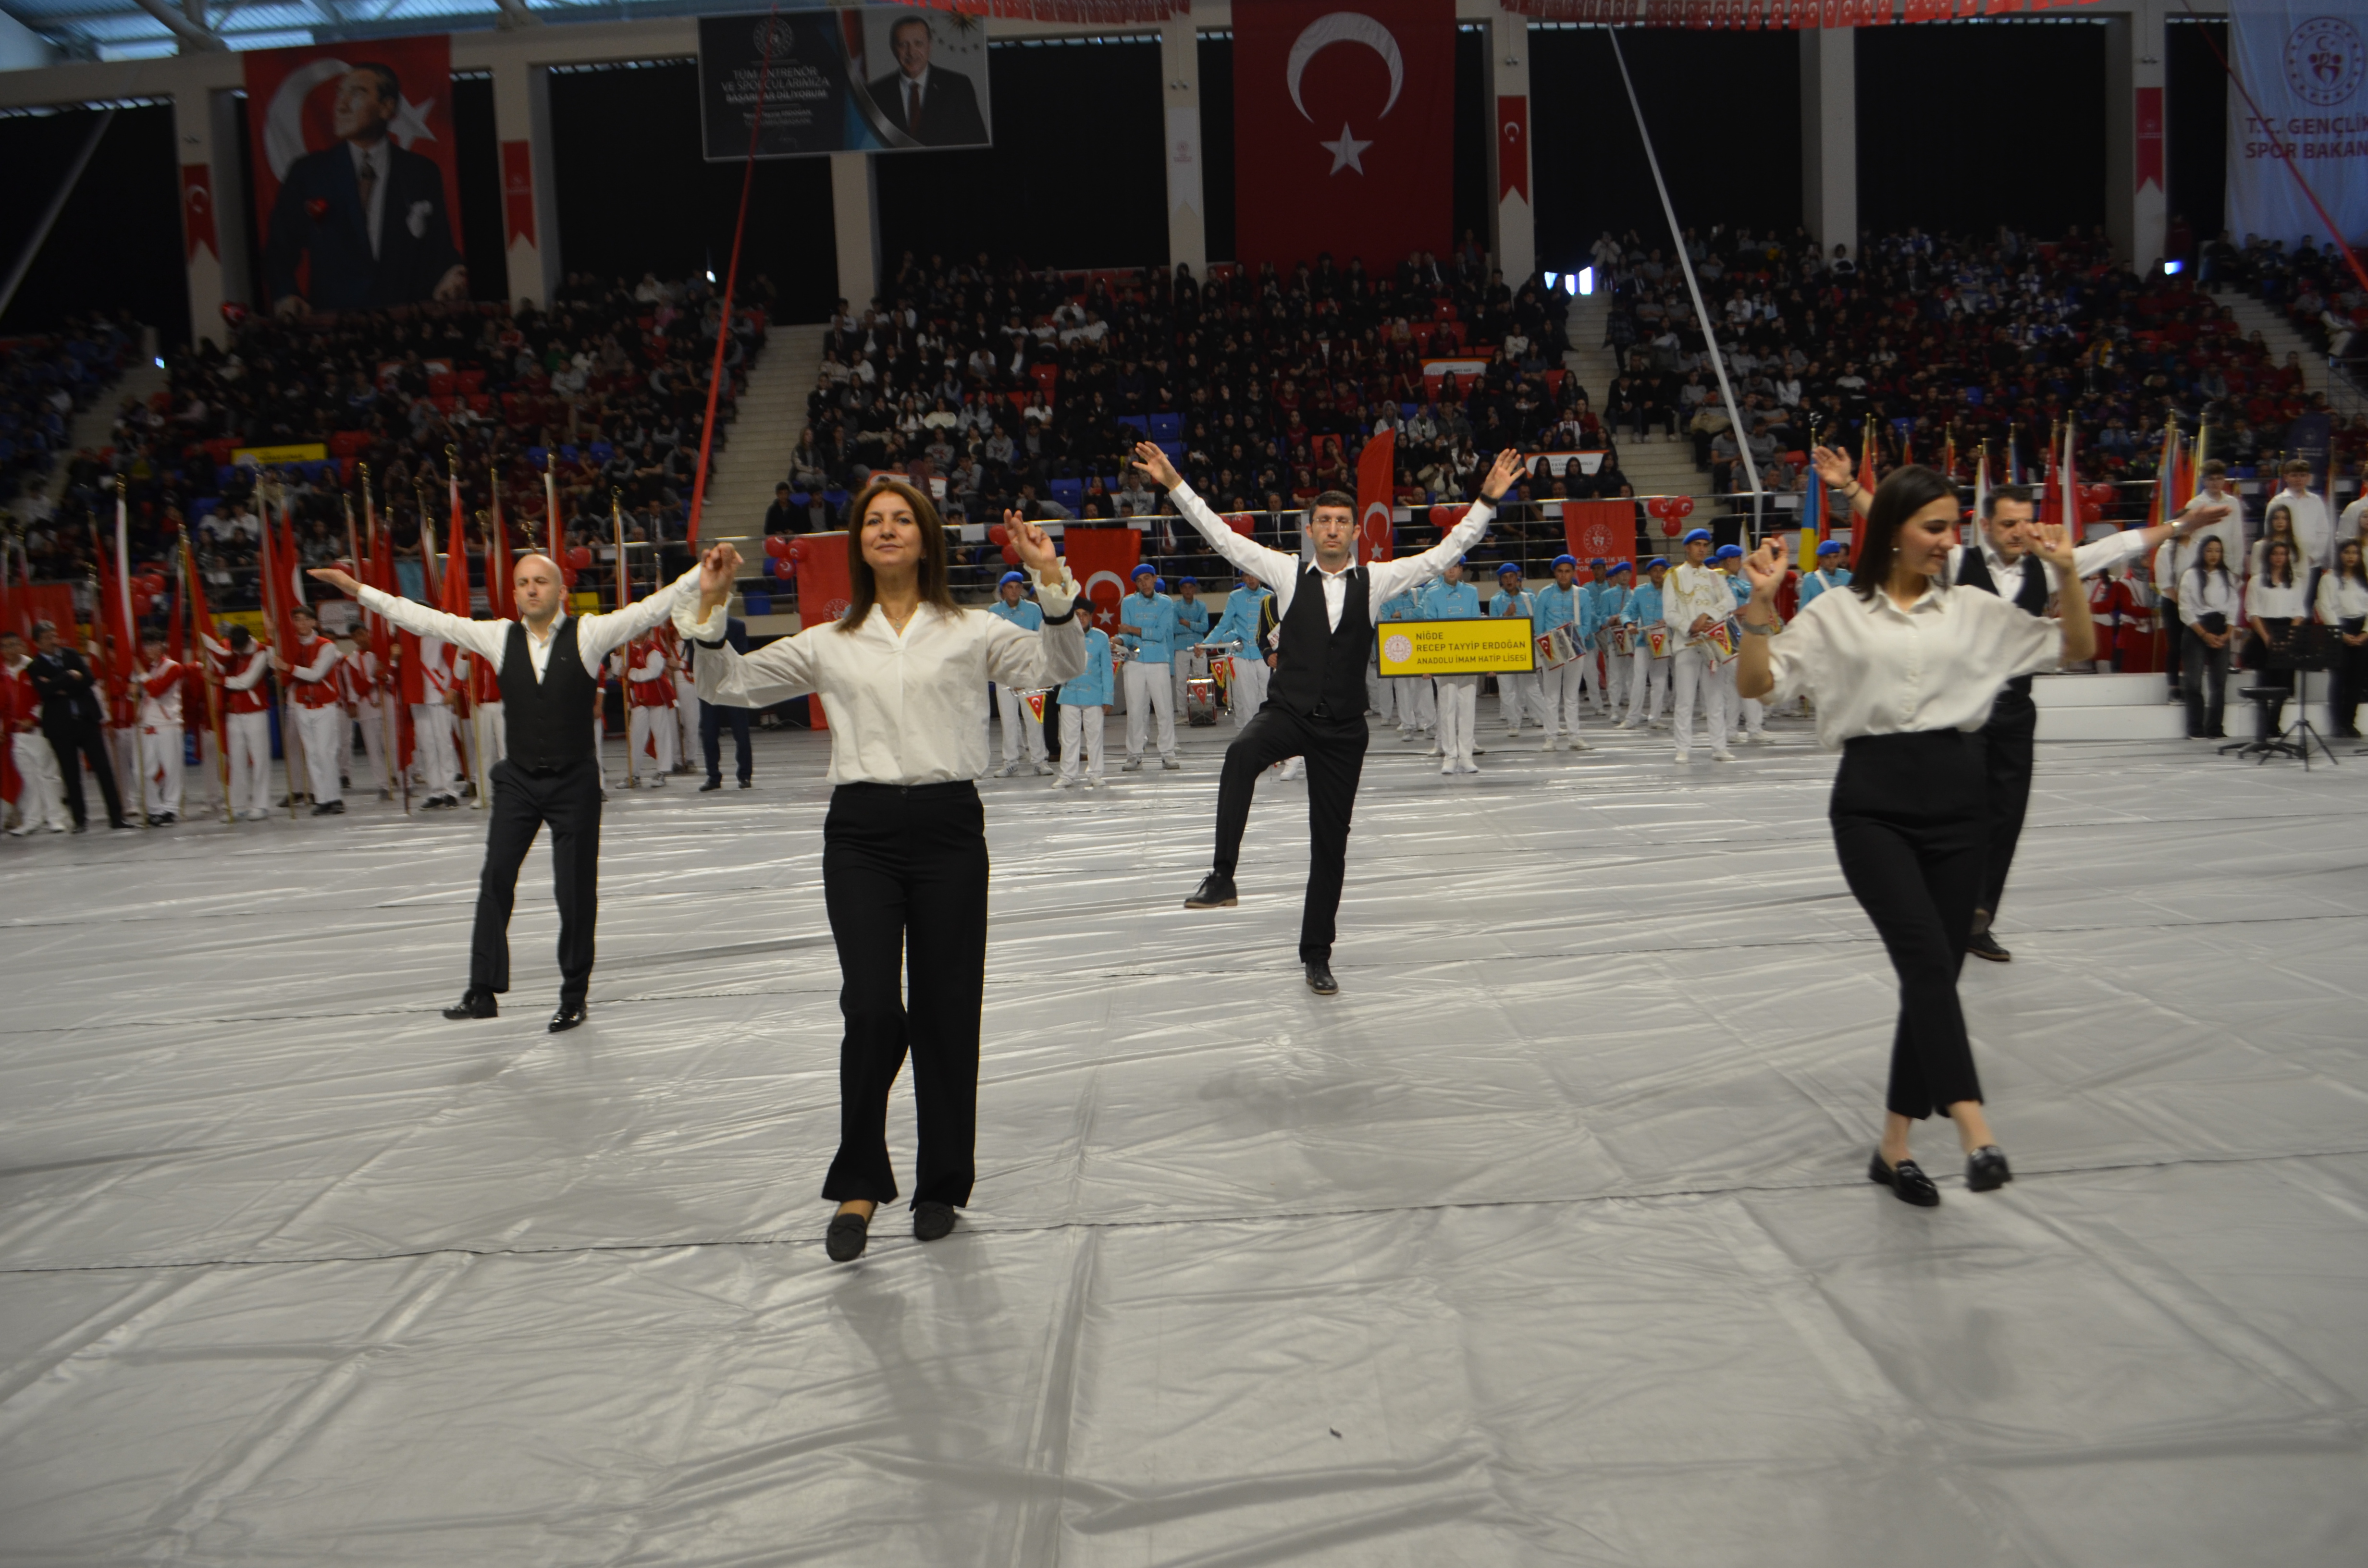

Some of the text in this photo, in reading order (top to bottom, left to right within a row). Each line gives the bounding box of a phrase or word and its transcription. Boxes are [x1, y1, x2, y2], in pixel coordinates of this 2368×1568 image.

[733, 65, 818, 79] TÜM NTRENÖR
[721, 81, 735, 91] VE
[2245, 142, 2297, 159] SPOR
[1416, 631, 1443, 640] NİĞDE
[1417, 639, 1525, 651] RECEP TAYYİP ERDOĞAN
[1479, 653, 1501, 662] HATİP
[1503, 652, 1527, 662] LİSESİ
